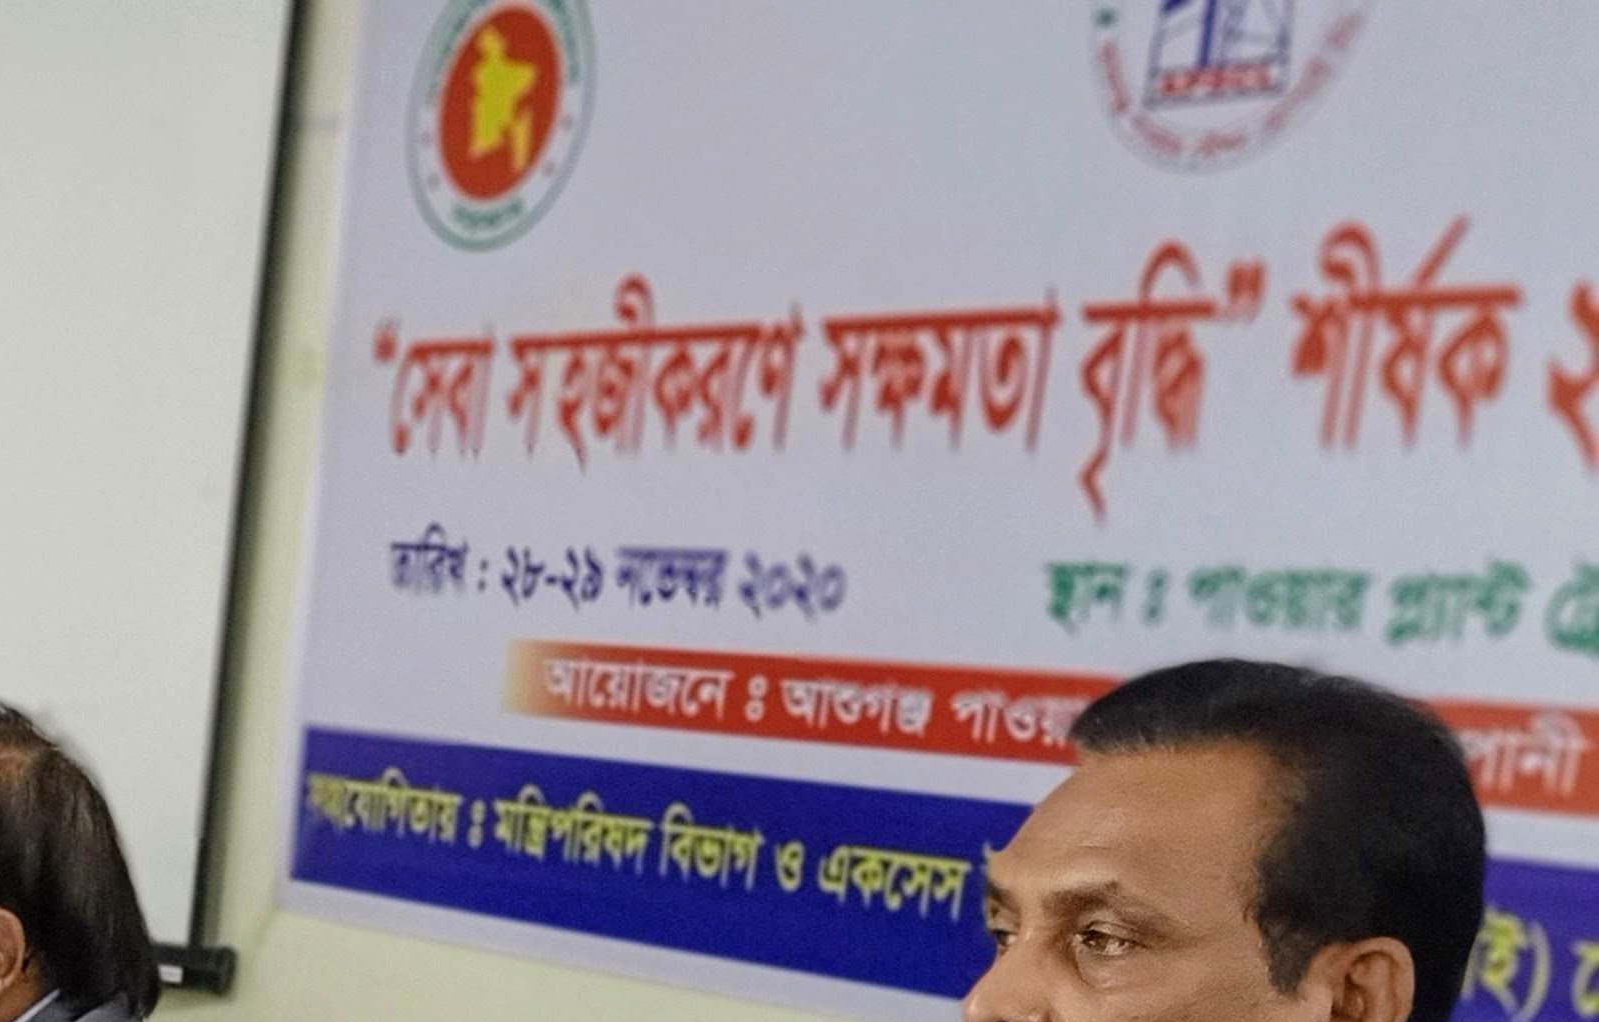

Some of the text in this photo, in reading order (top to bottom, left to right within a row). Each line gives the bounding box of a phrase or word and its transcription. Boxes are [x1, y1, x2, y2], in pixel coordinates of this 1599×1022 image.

[507, 272, 805, 474] সহজীকরণে
[817, 286, 1061, 454] সক্ষমতা
[1289, 212, 1524, 453] শীর্ষক
[390, 522, 469, 595] তারিখ
[736, 550, 848, 622] ২০২০
[543, 655, 736, 720] আয়োজনে
[659, 801, 766, 892] বিভাগ
[774, 841, 806, 893] ও
